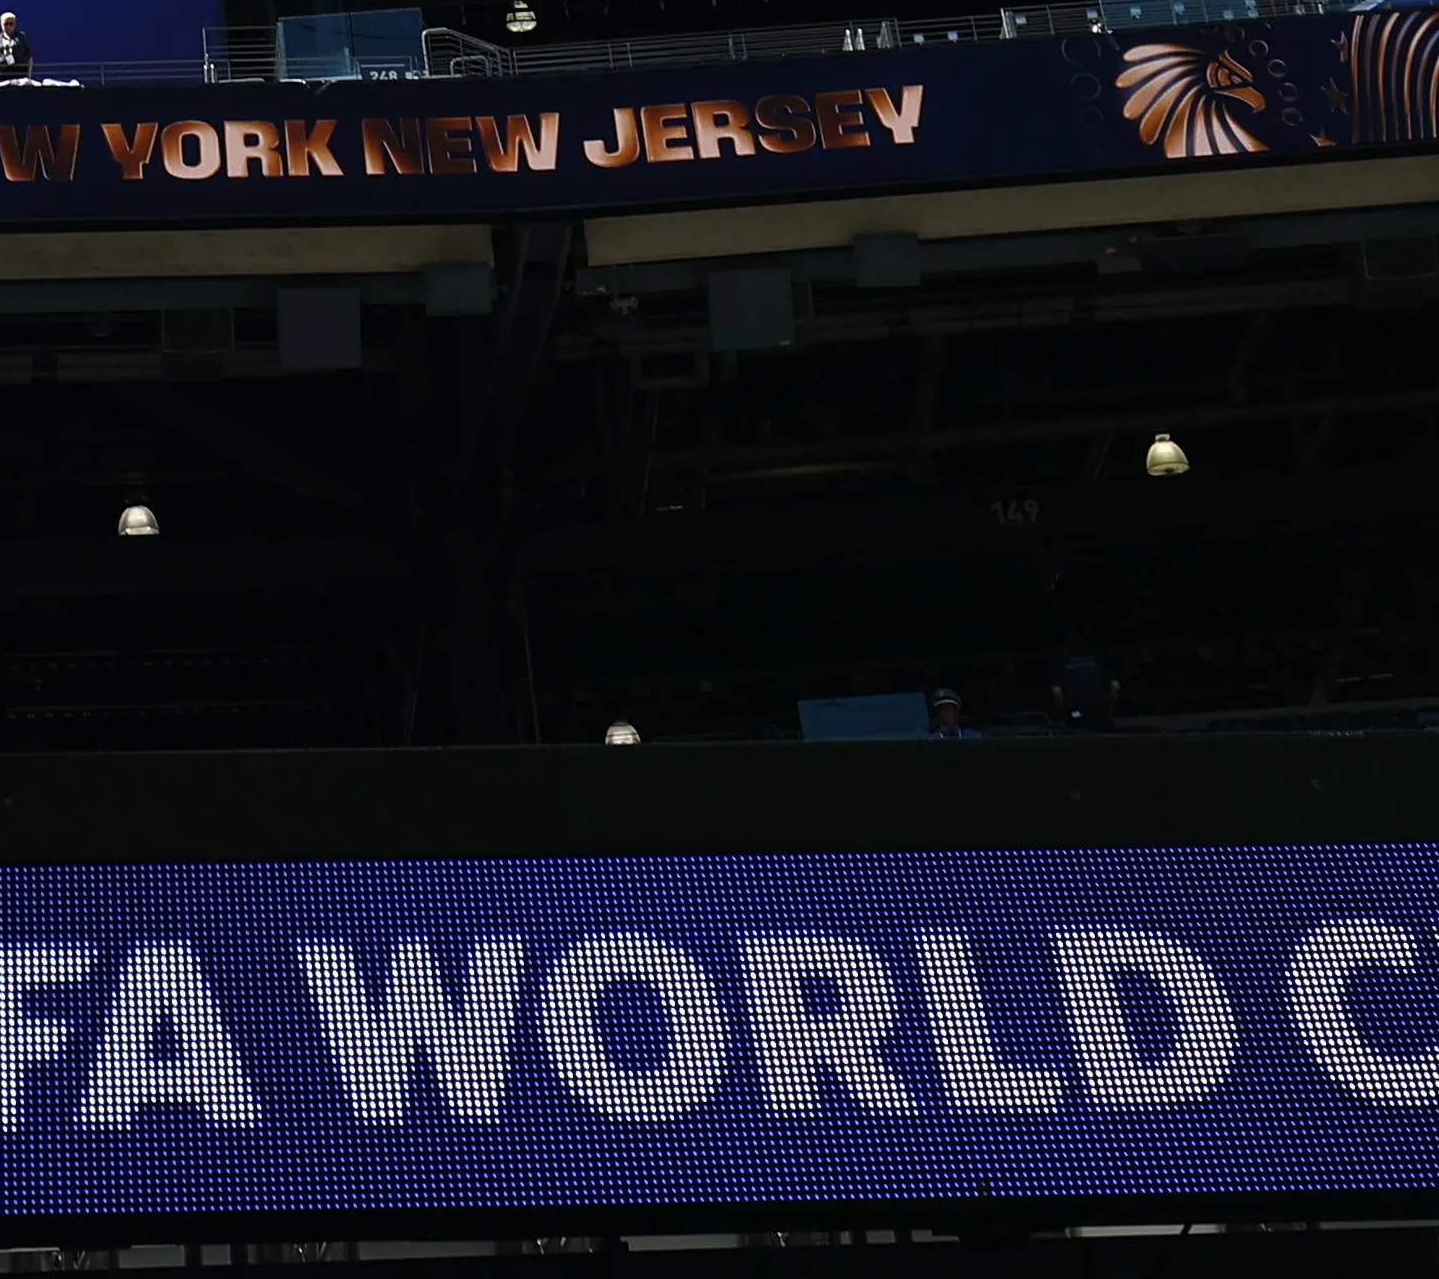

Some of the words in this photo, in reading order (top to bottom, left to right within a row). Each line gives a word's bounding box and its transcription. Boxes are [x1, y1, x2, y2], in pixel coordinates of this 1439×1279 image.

[99, 118, 344, 180] YORK
[360, 110, 561, 177] NEW
[582, 83, 926, 171] JERSEY
[989, 498, 1041, 526] 149
[288, 919, 1241, 1129] WORLD
